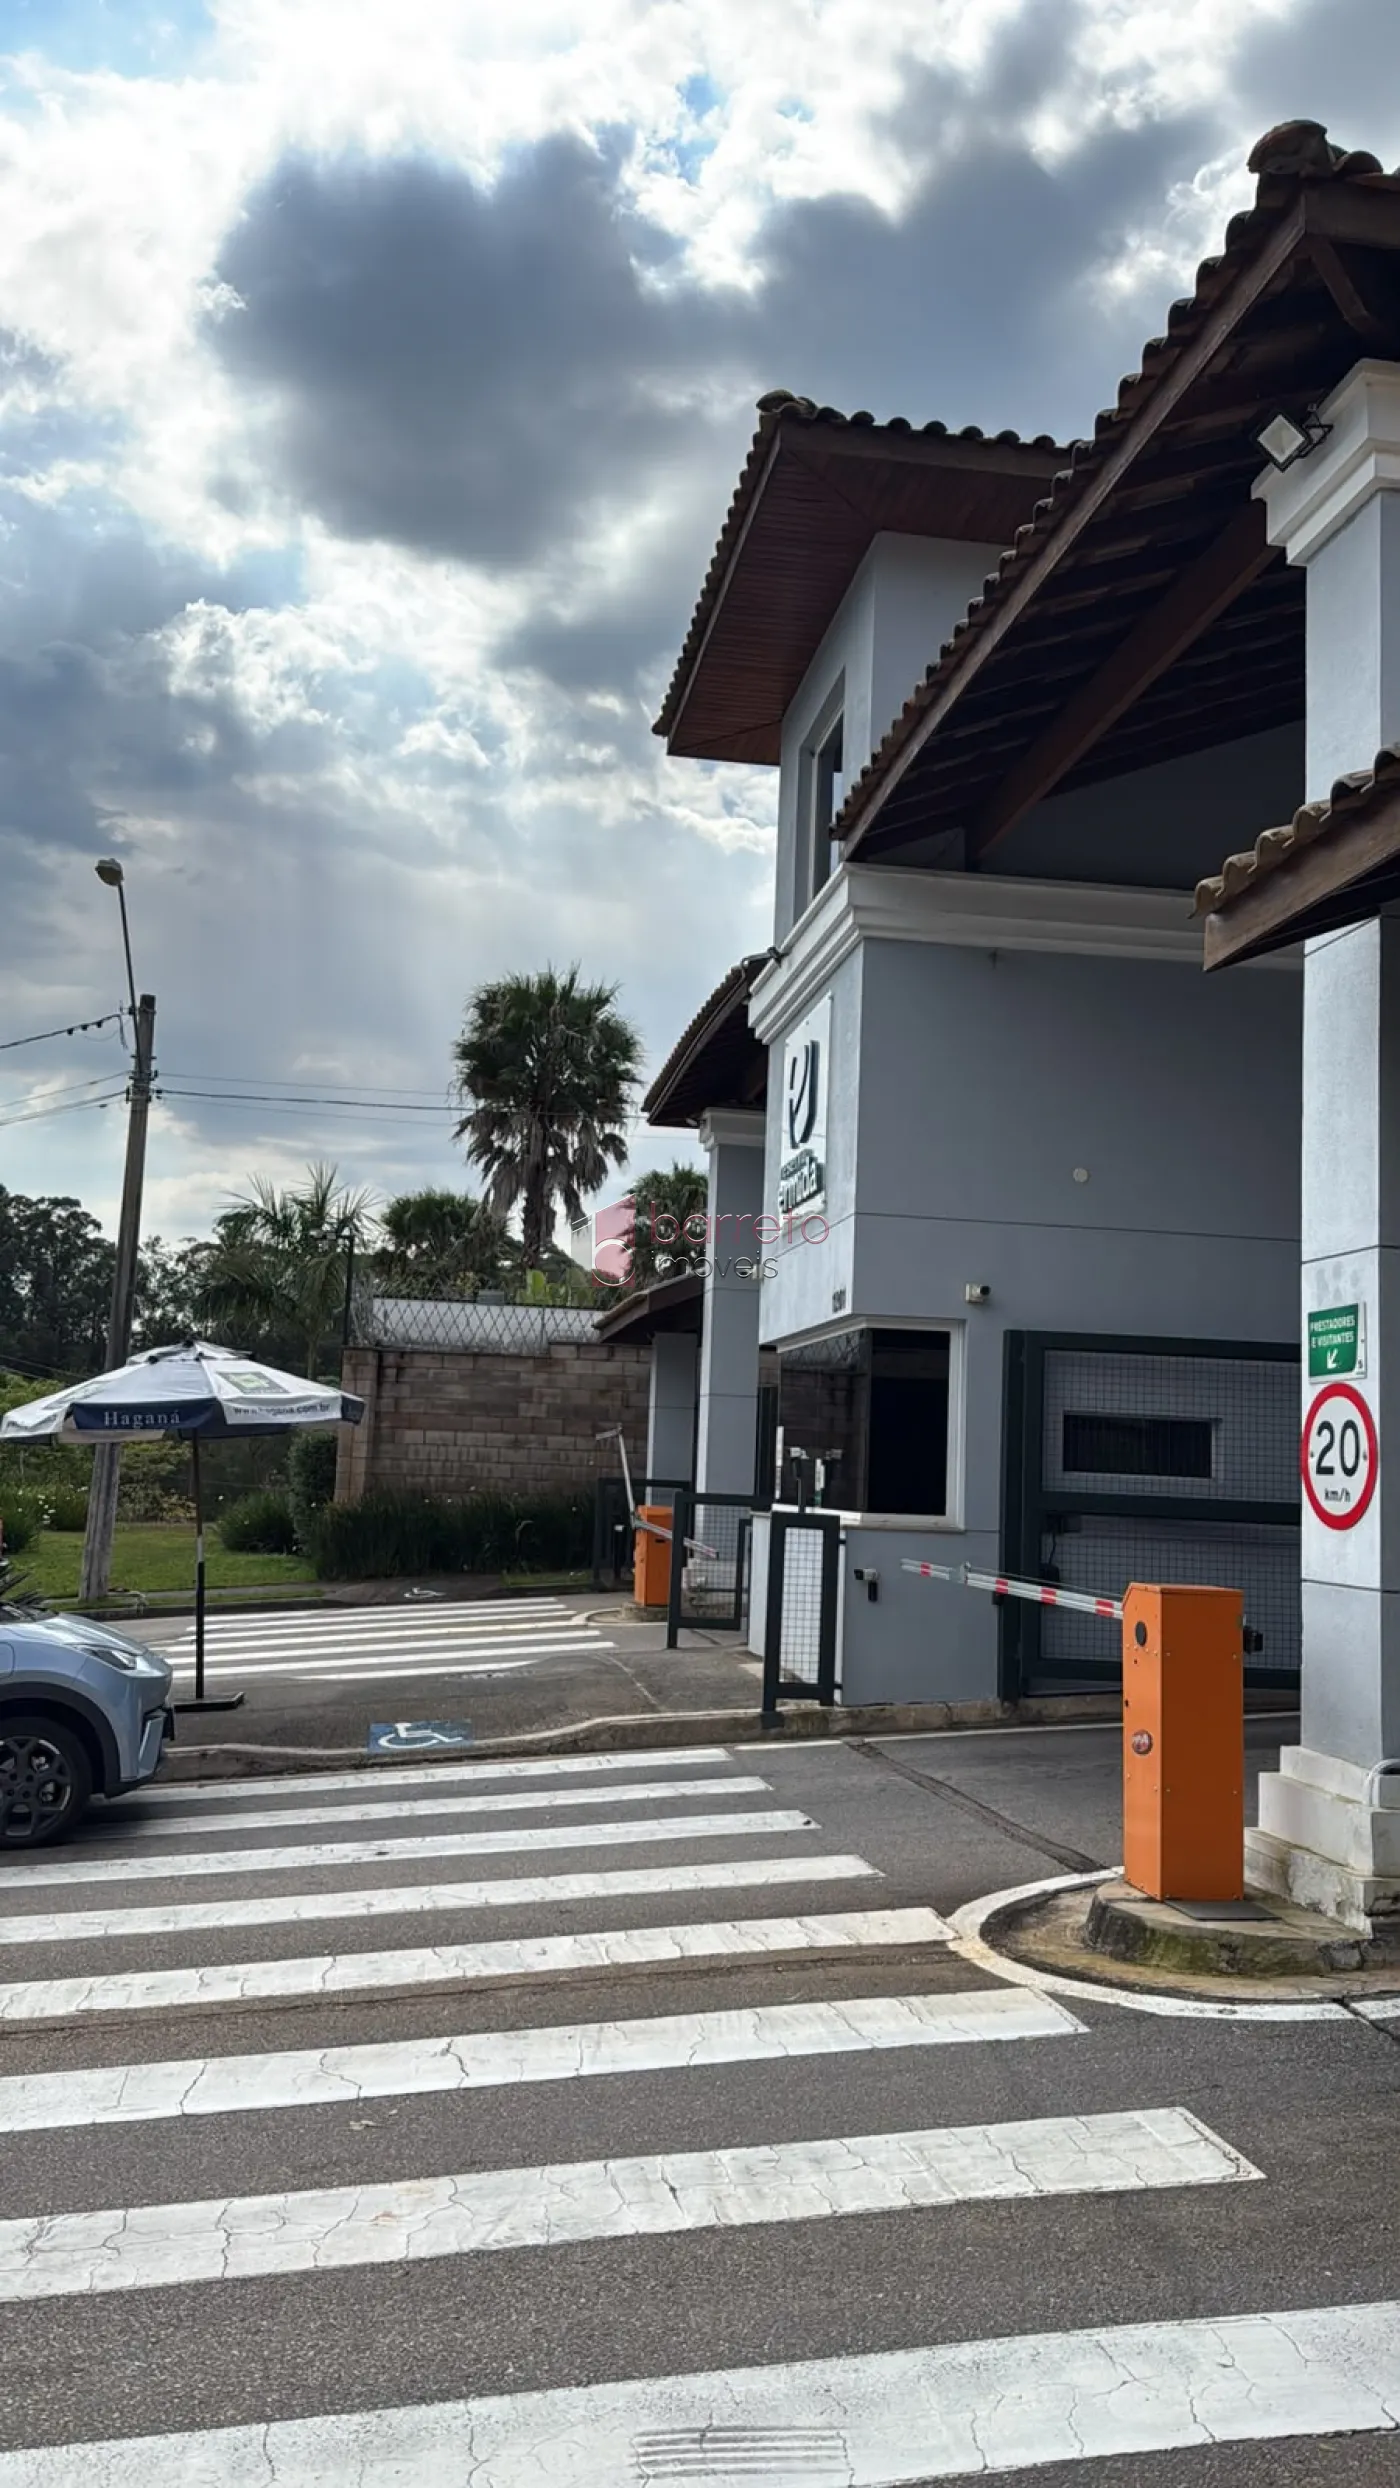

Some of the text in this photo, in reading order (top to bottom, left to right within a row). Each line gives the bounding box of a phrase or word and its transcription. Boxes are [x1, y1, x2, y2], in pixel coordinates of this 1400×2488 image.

[1310, 1315, 1355, 1333] PRESTADORES
[1318, 1330, 1354, 1346] VISITANTES
[104, 1409, 180, 1430] Haganá
[1316, 1420, 1360, 1477] 20
[1324, 1487, 1351, 1502] km/h
